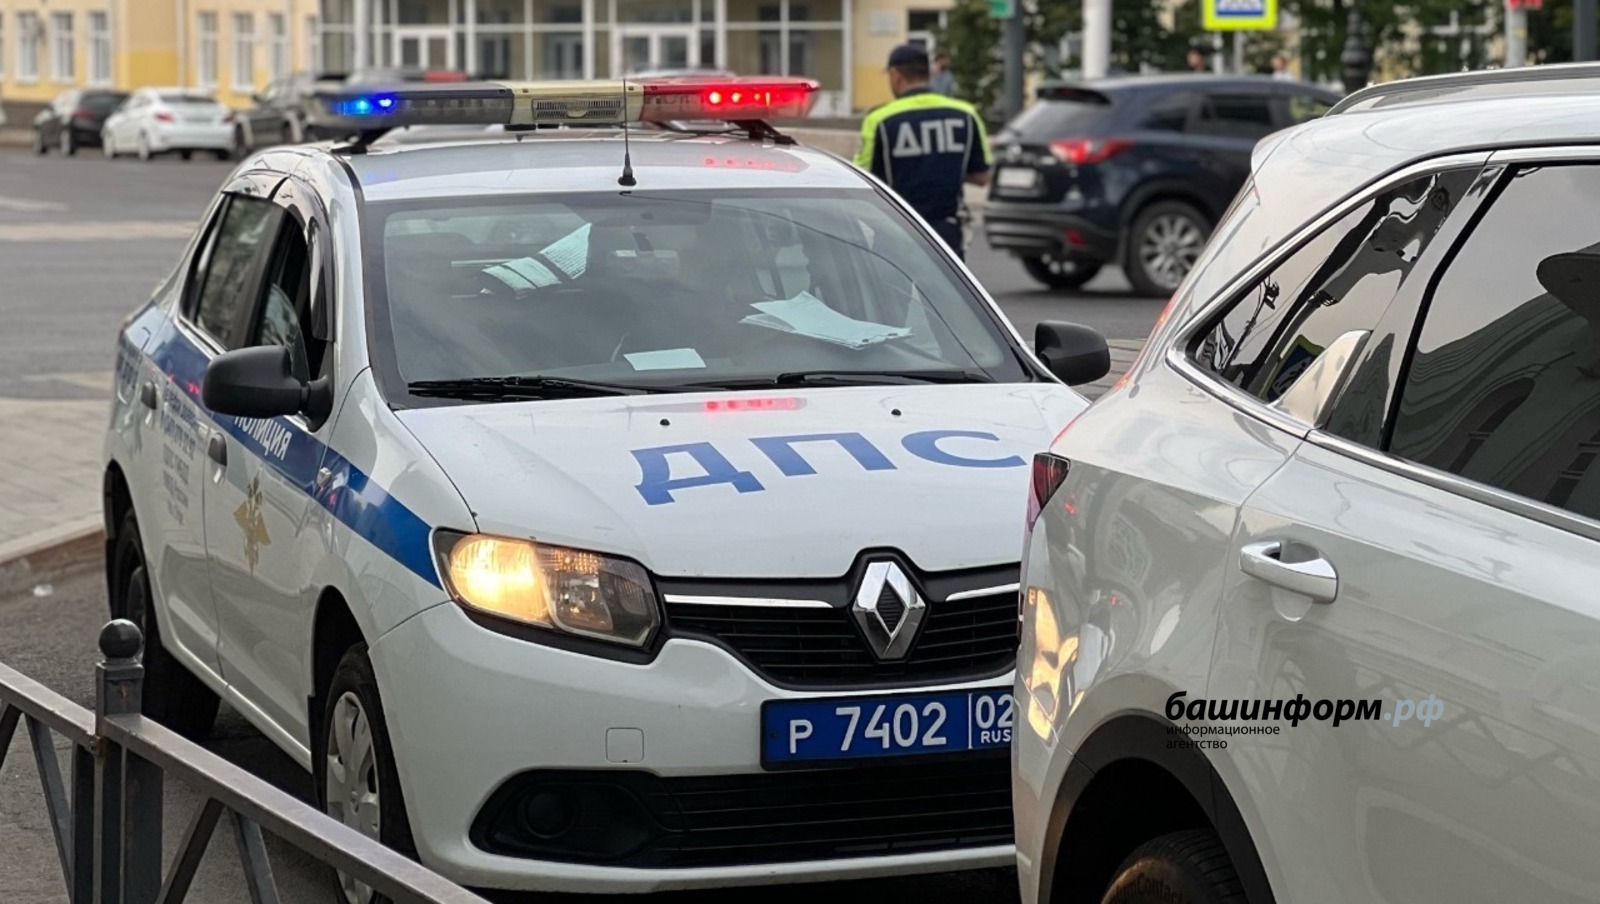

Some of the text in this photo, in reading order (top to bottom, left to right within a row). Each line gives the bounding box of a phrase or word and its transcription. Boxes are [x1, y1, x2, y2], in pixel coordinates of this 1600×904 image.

[892, 118, 965, 157] ДПС
[630, 429, 1028, 506] ДПС
[835, 702, 947, 751] 7402
[975, 694, 1013, 729] 02
[981, 729, 1012, 744] RUS
